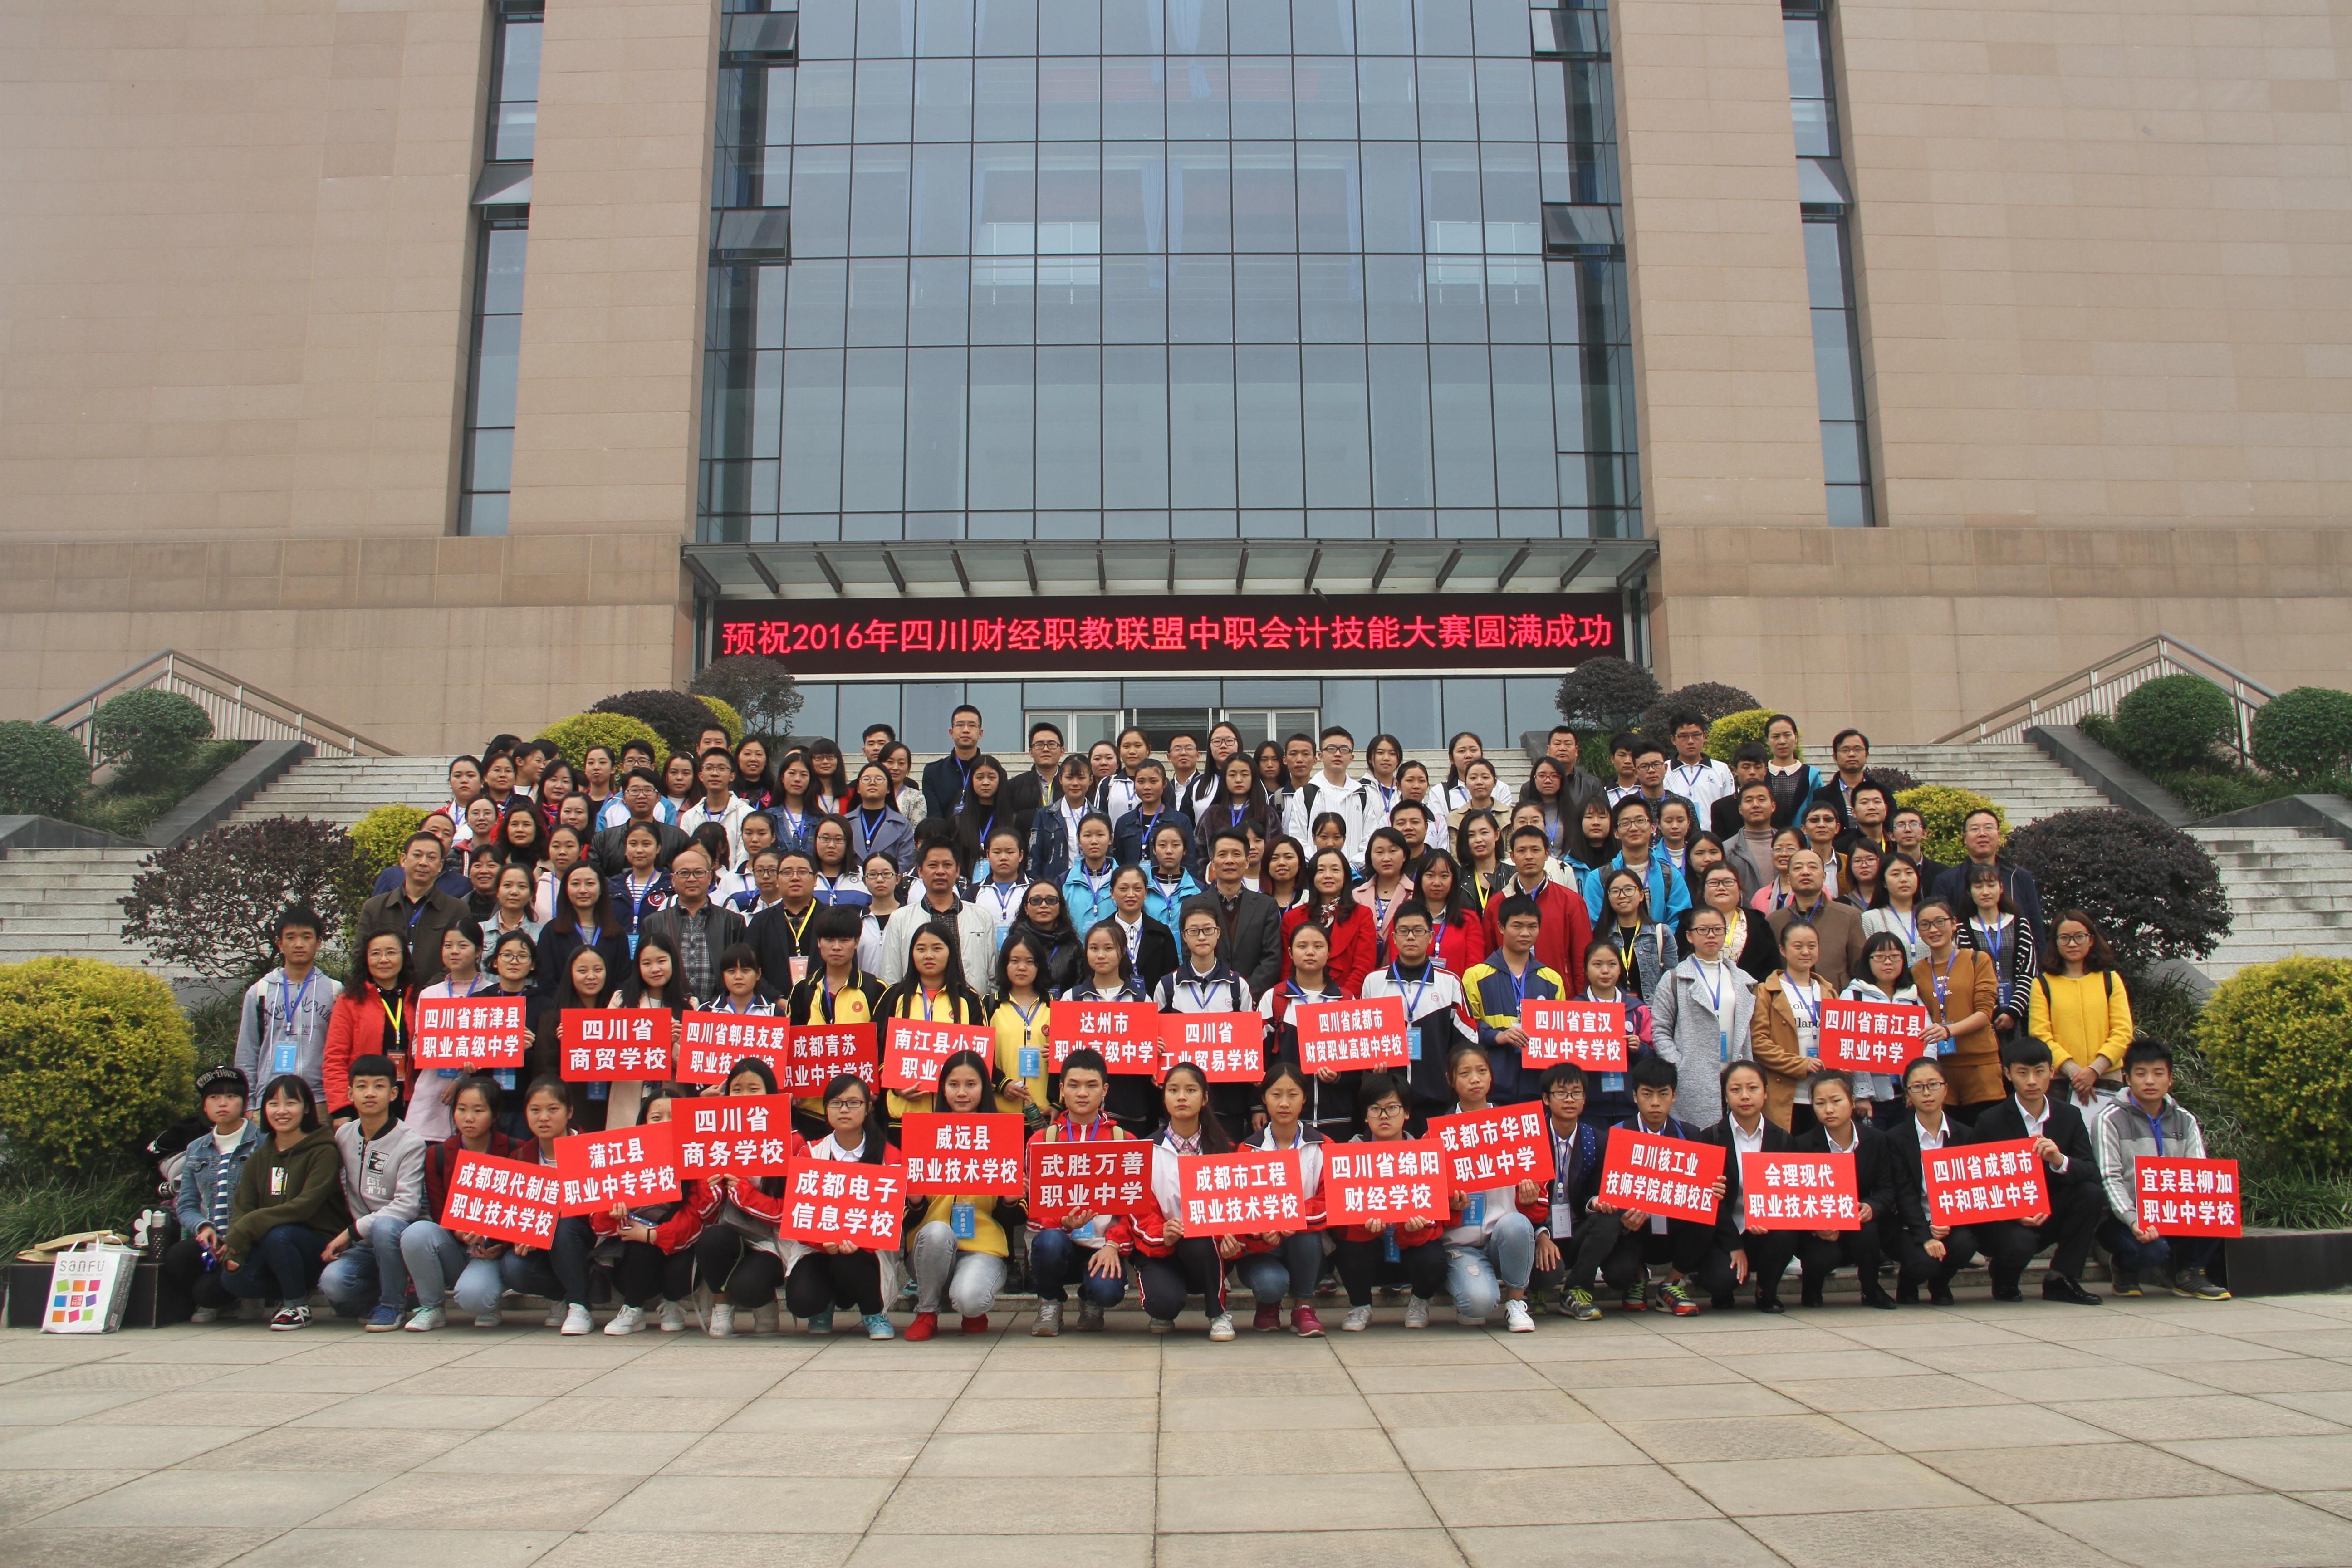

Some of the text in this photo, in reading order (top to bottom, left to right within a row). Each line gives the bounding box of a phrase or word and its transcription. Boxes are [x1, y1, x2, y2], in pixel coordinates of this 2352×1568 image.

[722, 613, 1611, 655] 预祝2016年四川财经职教联盟中职会计技能大赛圆满成功
[424, 1006, 520, 1029] 四川省新津县
[583, 1018, 654, 1041] 四川省
[1079, 1011, 1129, 1034] 达州市
[1318, 1007, 1383, 1033] 四川省成都市
[1535, 1010, 1612, 1033] 四川省宣汉
[1825, 1009, 1921, 1038] 四川省南江县
[421, 1034, 519, 1058] 职业高级中学
[686, 1022, 784, 1050] 四川省郫县友爱
[793, 1034, 857, 1058] 成都青苏
[894, 1027, 990, 1058] 南江县小河
[1185, 1021, 1234, 1044] 四川省
[569, 1047, 666, 1071] 商贸学校
[1304, 1034, 1403, 1063] 财贸职业高级中学校
[1527, 1036, 1621, 1062] 职业中专学校
[1839, 1038, 1904, 1064] 职业中学
[900, 1057, 944, 1083] 职业
[695, 1106, 769, 1133] 四川省
[1439, 1113, 1541, 1152] 成都市华阳
[936, 1124, 990, 1151] 威远县
[588, 1137, 645, 1169] 蒲江县
[682, 1138, 784, 1167] 商务学校
[1041, 1151, 1144, 1178] 武胜万善
[1331, 1151, 1440, 1180] 四川省绵阳
[1453, 1145, 1536, 1182] 职业中学
[1631, 1143, 1699, 1177] 四川核工业
[1933, 1149, 2033, 1183] 四川省成都市
[457, 1162, 560, 1205] 成都现代制造
[907, 1157, 1018, 1184] 职业技术学校
[1196, 1161, 1287, 1191] 成都市工程
[1764, 1162, 1835, 1188] 会理现代
[2141, 1167, 2233, 1194] 宜宾县柳加
[563, 1165, 677, 1205] 职业中专学校
[794, 1169, 898, 1203] 成都电子
[1039, 1181, 1143, 1209] 职业中学
[1344, 1183, 1432, 1212] 财经学校
[1606, 1170, 1714, 1212] 技师学院成都校区
[1938, 1180, 2039, 1215] 中和职业中学
[449, 1193, 554, 1237] 职业技术学校
[791, 1202, 895, 1238] 信息学校
[1188, 1192, 1299, 1225] 职业技术学校
[1748, 1194, 1855, 1219] 职业技术学校
[2143, 1199, 2235, 1226] 职业中学校
